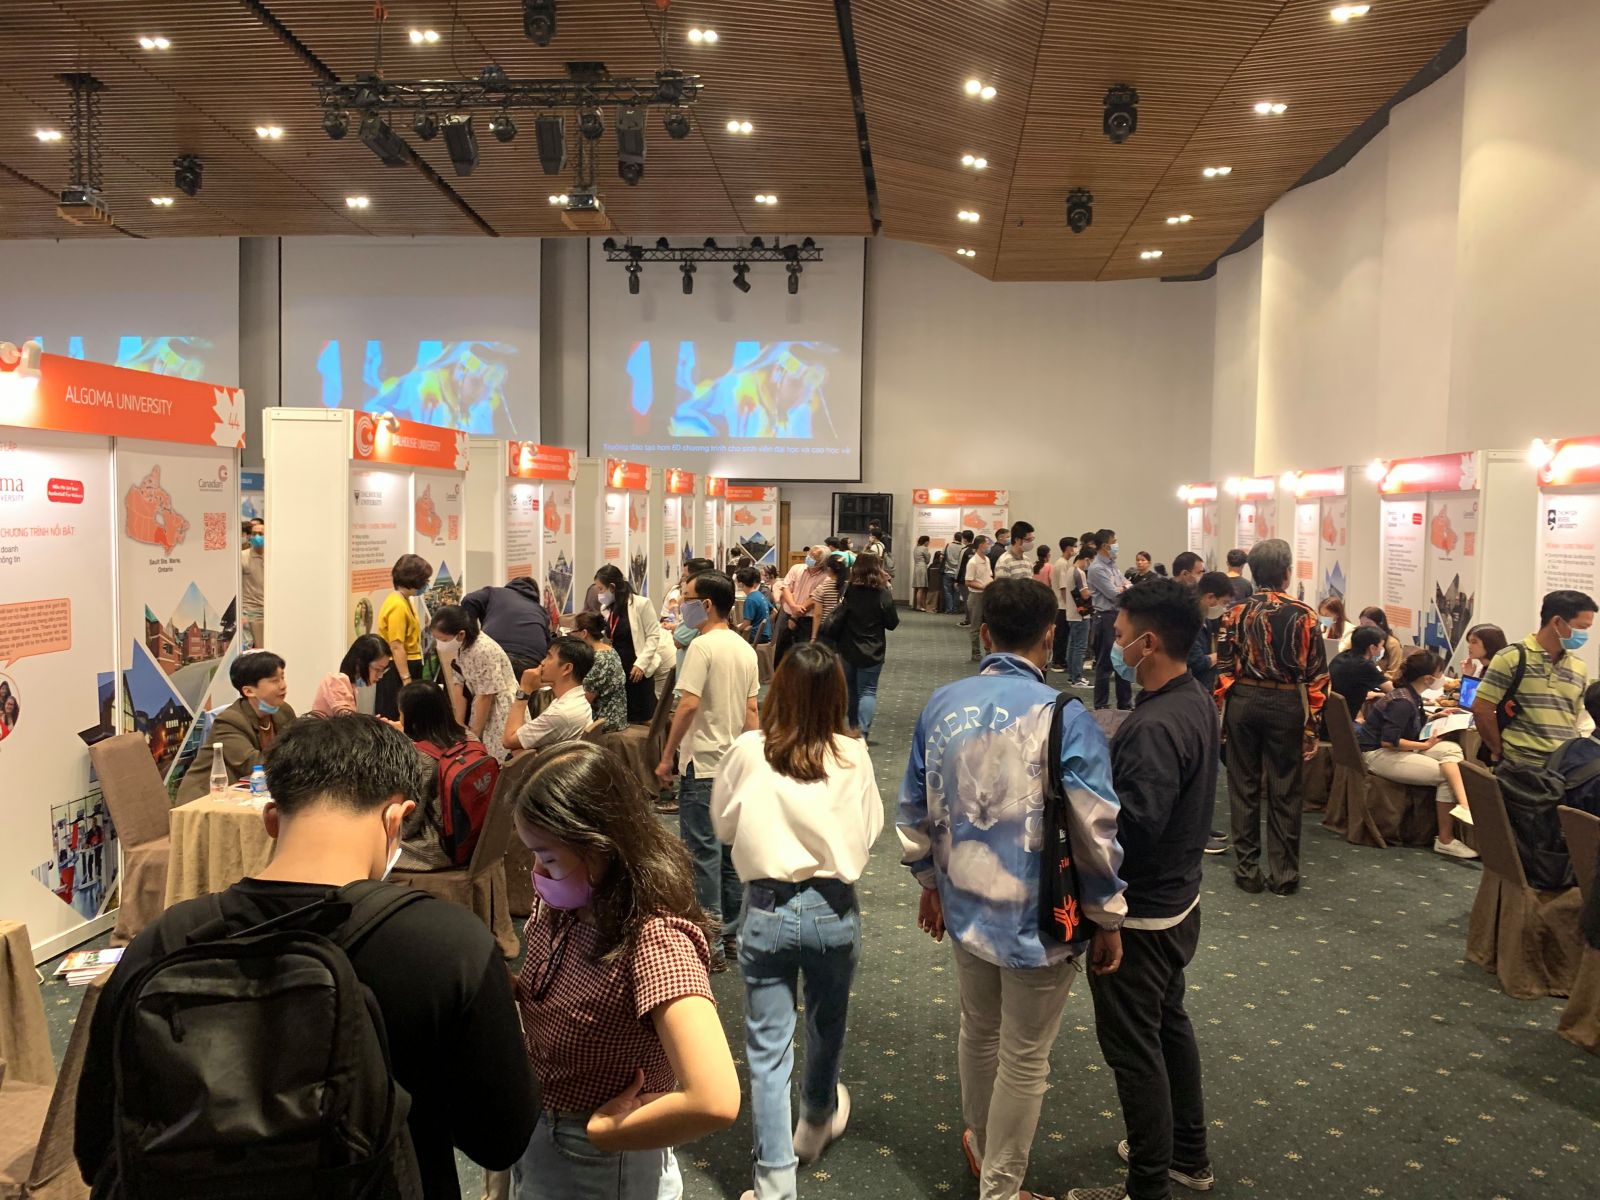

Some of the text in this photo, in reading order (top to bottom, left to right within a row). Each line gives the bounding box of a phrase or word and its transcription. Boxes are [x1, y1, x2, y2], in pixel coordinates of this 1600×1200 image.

[65, 385, 173, 416] ALGOMA UNIVERSITY
[228, 412, 240, 430] 44
